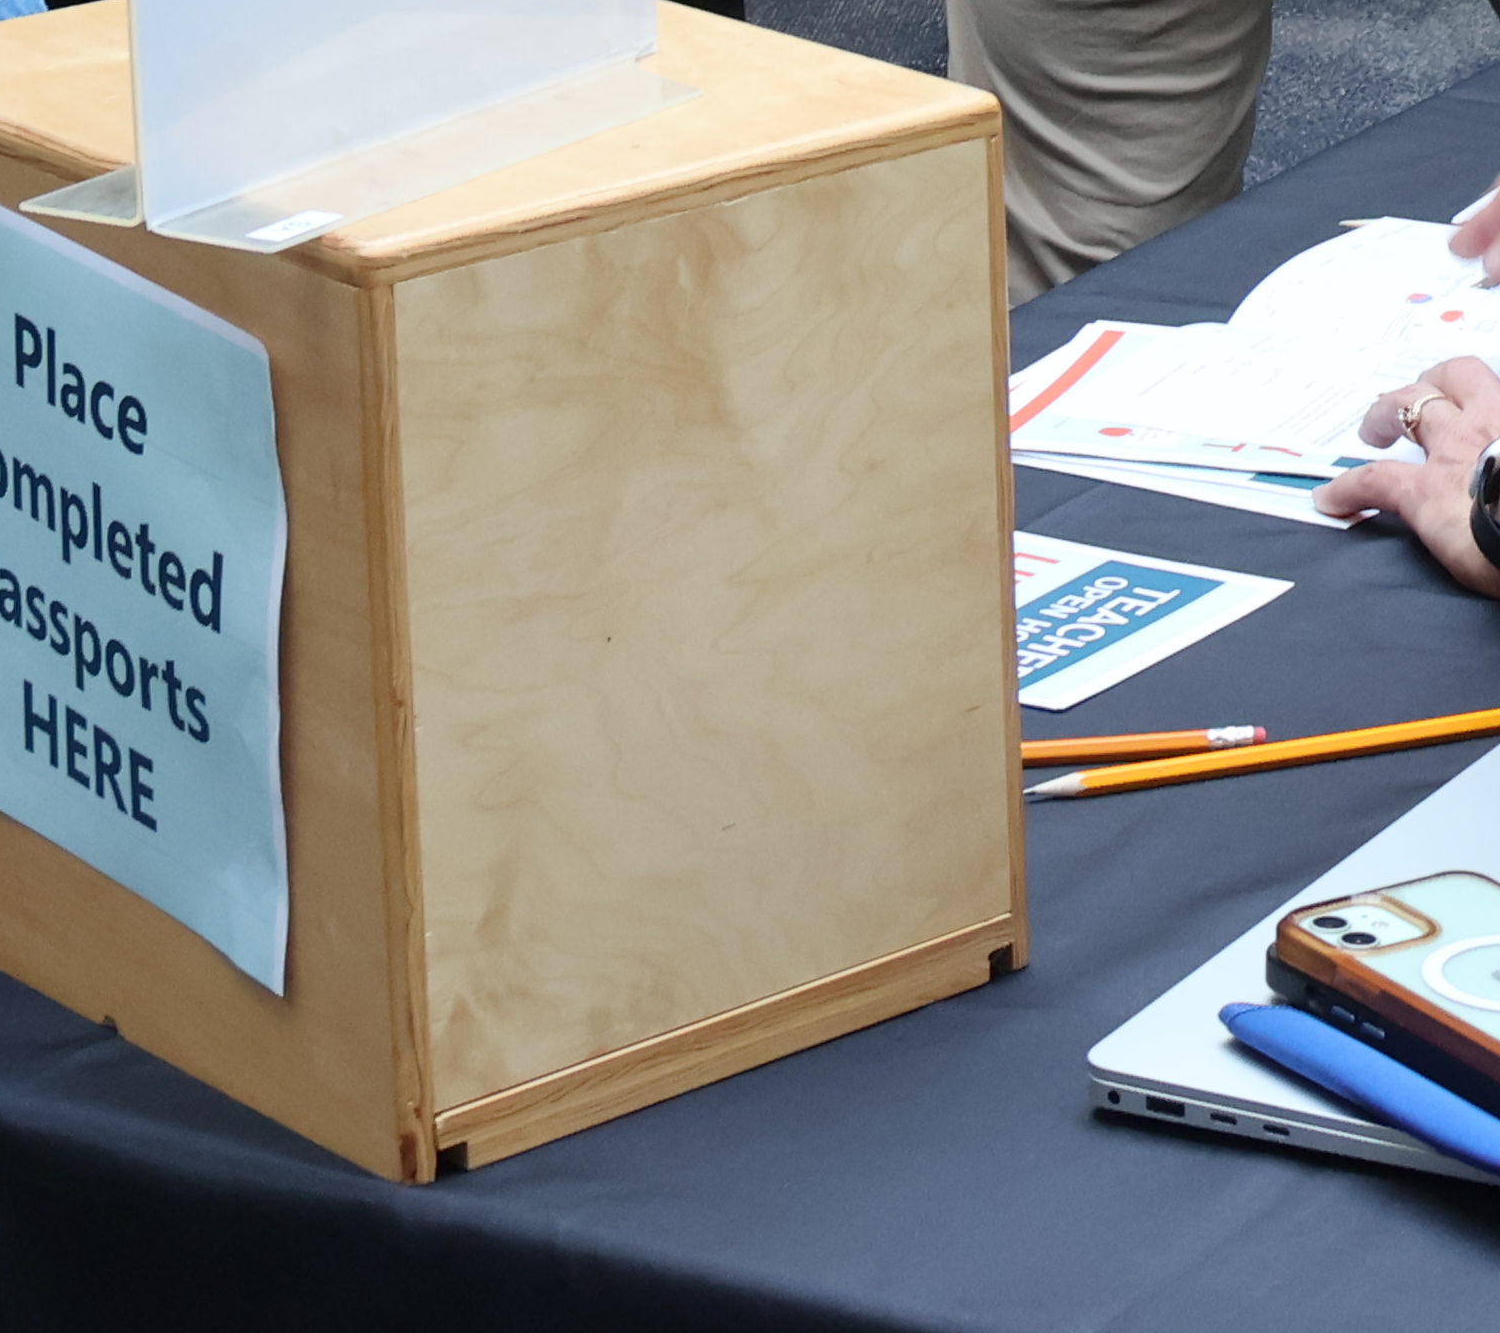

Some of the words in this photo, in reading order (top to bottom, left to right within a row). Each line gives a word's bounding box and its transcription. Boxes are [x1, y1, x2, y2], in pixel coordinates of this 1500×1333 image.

[12, 311, 149, 457] Place
[1038, 575, 1130, 620] OPEN
[21, 678, 159, 833] HERE
